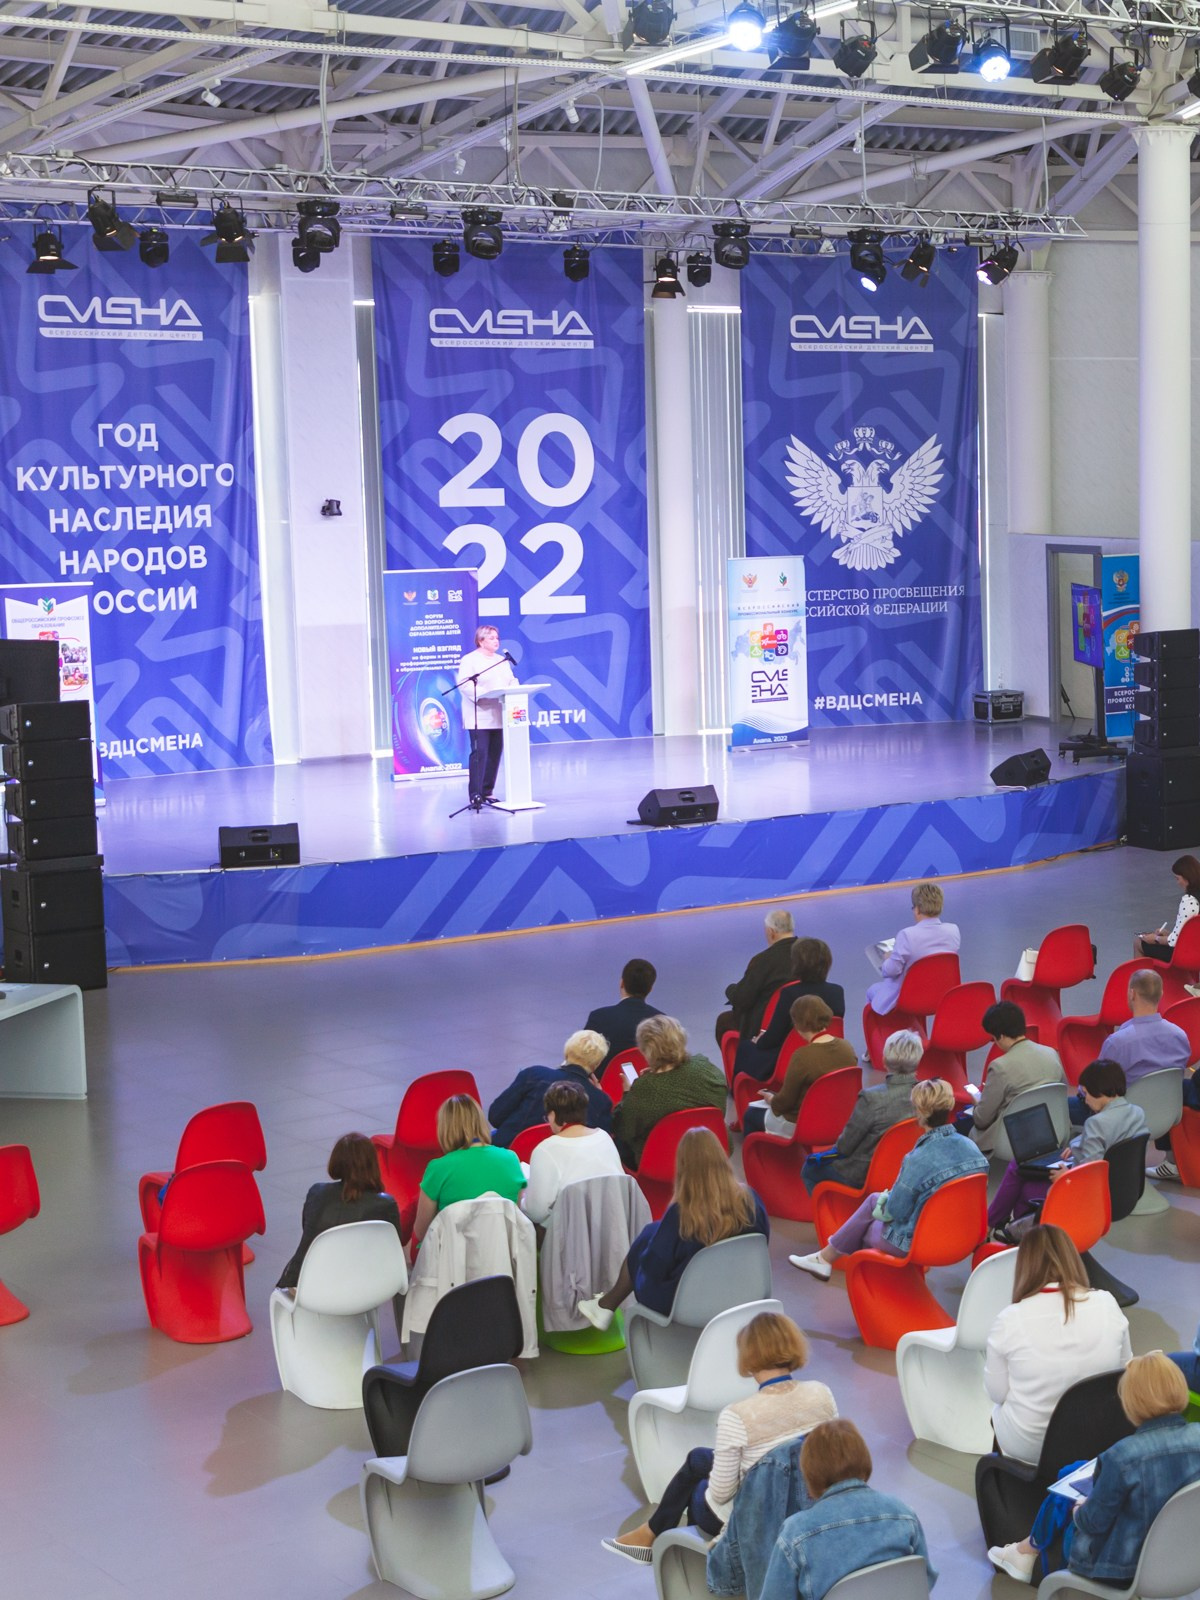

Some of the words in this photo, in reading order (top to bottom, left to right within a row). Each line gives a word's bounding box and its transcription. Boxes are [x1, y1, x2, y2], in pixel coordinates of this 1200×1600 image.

[38, 294, 203, 326] СМЕНА
[429, 308, 594, 336] СМЕНА
[48, 329, 123, 338] всероссийский
[127, 331, 164, 339] детский
[169, 332, 197, 340] центр
[790, 314, 934, 340] СМЕНА
[439, 339, 513, 347] всероссийский
[517, 340, 556, 348] детский
[560, 341, 589, 349] центр
[98, 423, 159, 452] ГОД
[438, 412, 595, 507] 20
[16, 462, 234, 492] КУЛЬТУРНОГО
[49, 504, 212, 534] НАСЛЕДИЯ
[59, 545, 208, 576] НАРОДОВ
[442, 522, 586, 617] 22
[93, 586, 198, 616] ОССИИ
[804, 588, 869, 602] СТЕРСТВО
[872, 585, 965, 601] ПРОСВЕЩЕНИЯ
[424, 618, 454, 626] ВОПРОСАМ
[804, 602, 870, 618] ССИЙСКОЙ
[873, 601, 948, 616] ФЕДЕРАЦИИ
[413, 644, 437, 654] НОВЫЙ
[437, 644, 463, 653] ВЗГЛЯД
[814, 691, 923, 711] #ВДЦСМЕНА
[100, 732, 204, 760] ВДЦСМЕНА
